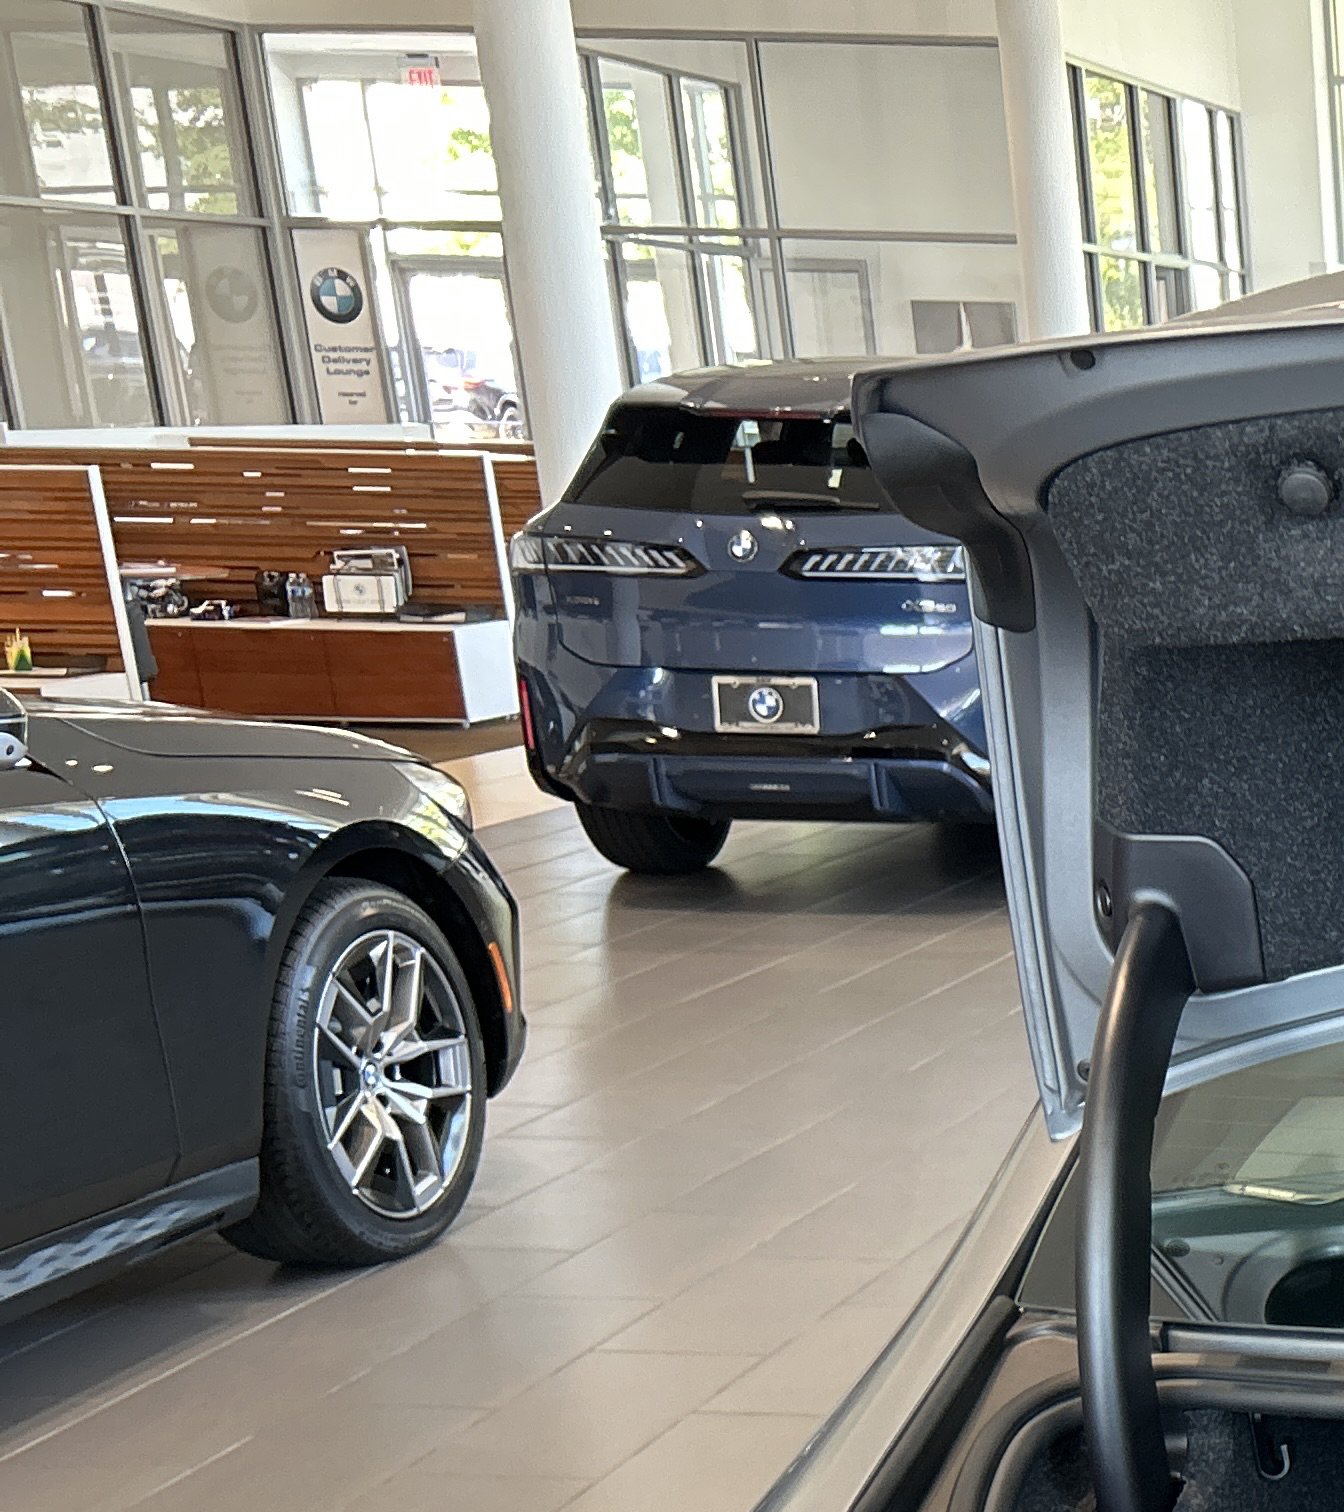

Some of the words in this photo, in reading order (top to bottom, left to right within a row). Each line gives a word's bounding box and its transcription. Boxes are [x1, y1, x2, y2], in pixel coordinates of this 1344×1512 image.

[315, 344, 376, 353] Customer
[322, 356, 371, 366] Delivery
[327, 368, 370, 378] Lounge
[293, 996, 309, 1089] Continental
